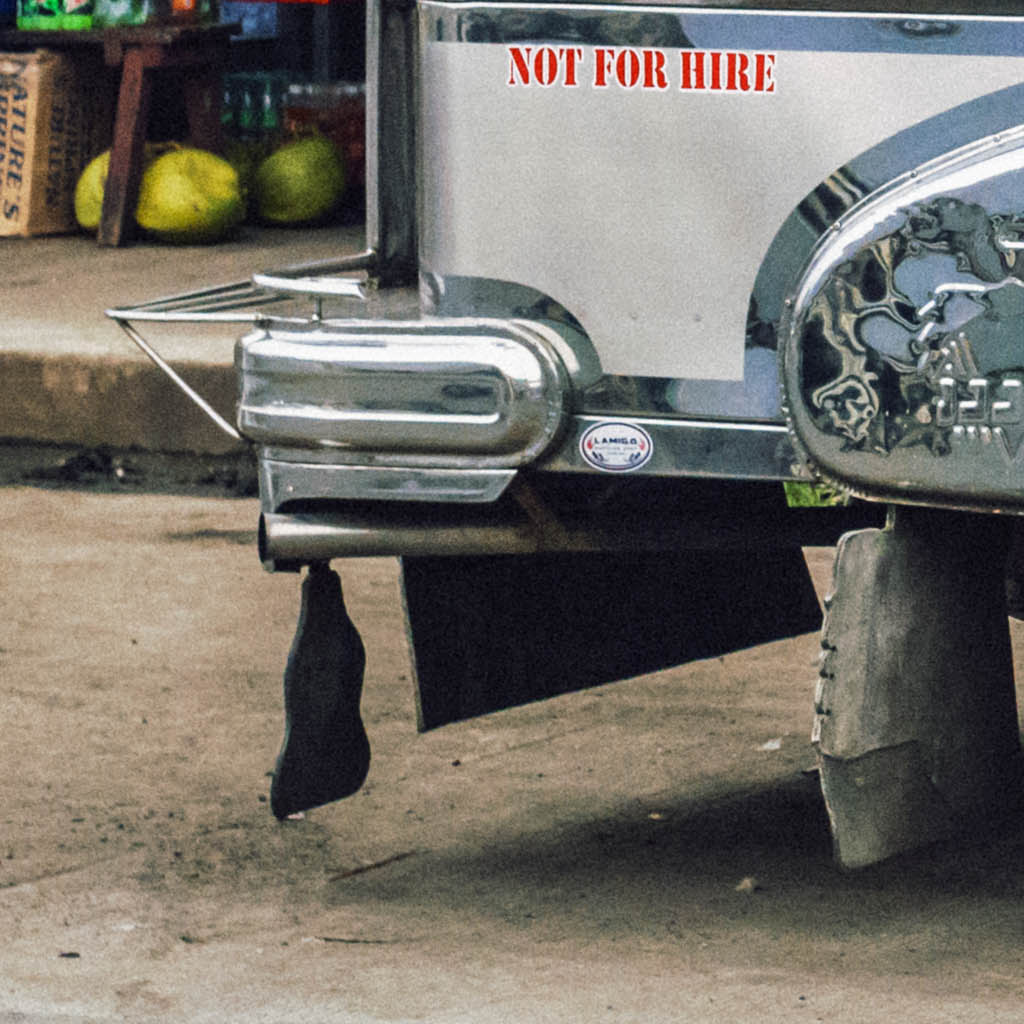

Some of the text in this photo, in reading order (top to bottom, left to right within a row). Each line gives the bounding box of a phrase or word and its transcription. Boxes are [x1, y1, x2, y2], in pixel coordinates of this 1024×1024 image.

[507, 46, 777, 94] NOT FOR HIRE
